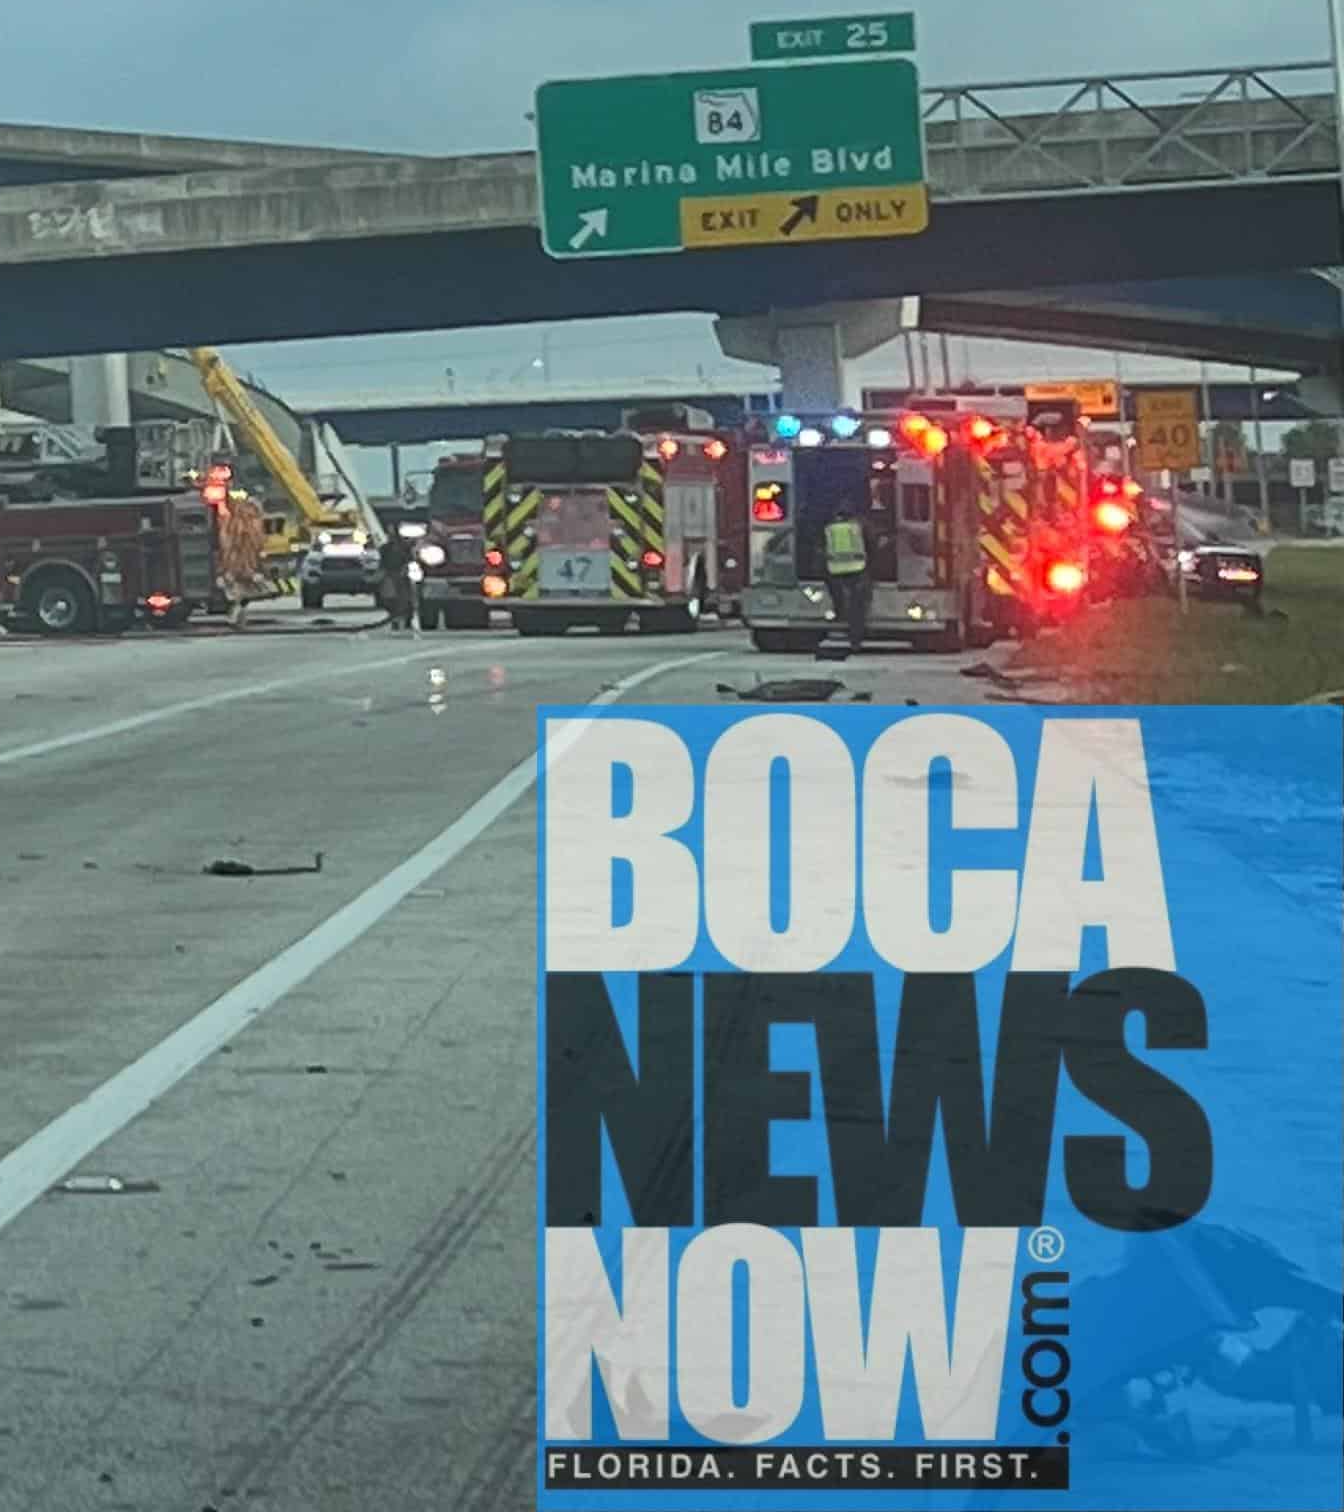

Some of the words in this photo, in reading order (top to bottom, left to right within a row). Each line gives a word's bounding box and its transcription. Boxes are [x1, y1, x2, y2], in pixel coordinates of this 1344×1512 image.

[776, 28, 824, 49] EXIT
[847, 21, 889, 49] 25
[707, 110, 744, 135] 84
[570, 162, 697, 190] Marina
[716, 154, 791, 182] Mile
[811, 145, 893, 175] Blvd
[701, 208, 760, 232] EXIT
[836, 199, 907, 223] ONLY
[556, 556, 593, 584] 47
